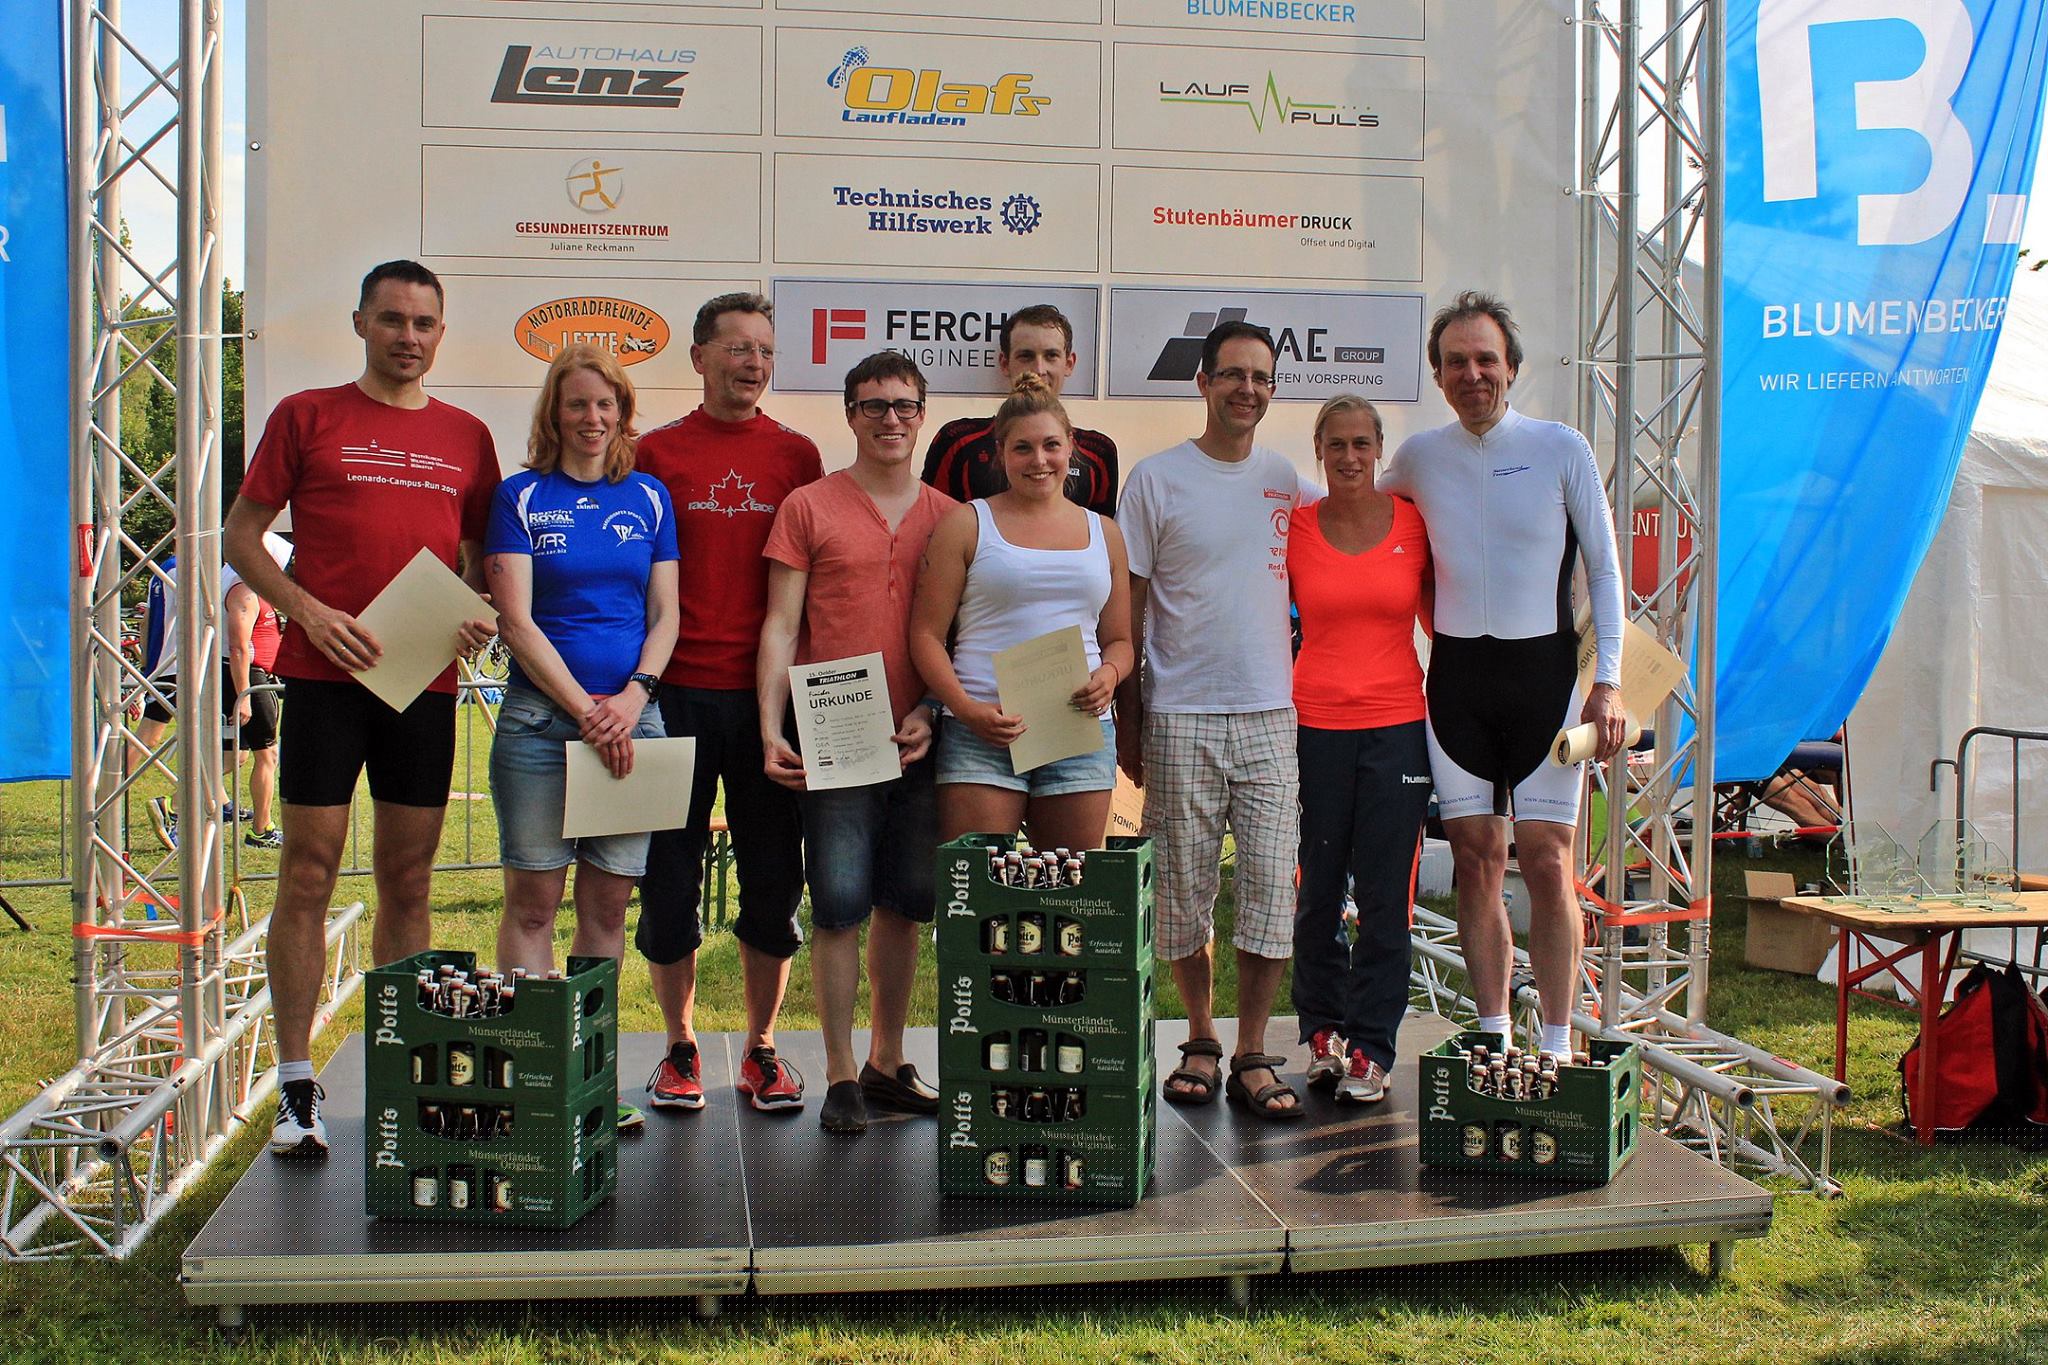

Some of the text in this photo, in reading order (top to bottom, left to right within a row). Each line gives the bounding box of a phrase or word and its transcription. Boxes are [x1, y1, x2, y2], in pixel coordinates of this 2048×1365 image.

[1187, 0, 1355, 22] BLUMENBECKER
[534, 46, 697, 64] AUTOHAUS
[490, 45, 690, 108] Lenz
[845, 67, 1052, 116] Olafs
[1160, 81, 1249, 96] LAUF
[842, 110, 966, 126] Laufladen
[833, 186, 992, 211] Technisches
[515, 221, 669, 237] GESUNDHEITSZENTRUM
[868, 212, 992, 234] Hilfswerk
[550, 242, 635, 253] Juliane Reckmann
[1301, 237, 1376, 250] Offset und Digital
[528, 300, 654, 331] MOTORRADFREUNDE
[1762, 297, 2008, 338] BLUMENBECKER
[886, 309, 1008, 343] FERCH
[886, 348, 996, 368] NGINEE
[1341, 350, 1380, 361] GROUP
[1276, 372, 1383, 385] FEN VORSPRUNG
[1760, 373, 1799, 391] WIR
[1808, 371, 1889, 390] LIEFERN
[347, 473, 440, 491] Leonardo-Campus-Run
[529, 513, 574, 524] ROYAL
[819, 672, 857, 684] TRIATHLON
[809, 690, 873, 709] URKUNDE
[947, 859, 976, 919] Pott's
[1040, 896, 1112, 908] Münsterländer
[376, 984, 404, 1046] Pott's
[949, 976, 979, 1035] Pott's
[1042, 1014, 1114, 1026] Münsterländer
[1429, 1066, 1456, 1122] Pott's
[949, 1090, 979, 1149] Pott's
[376, 1106, 404, 1169] Pott's
